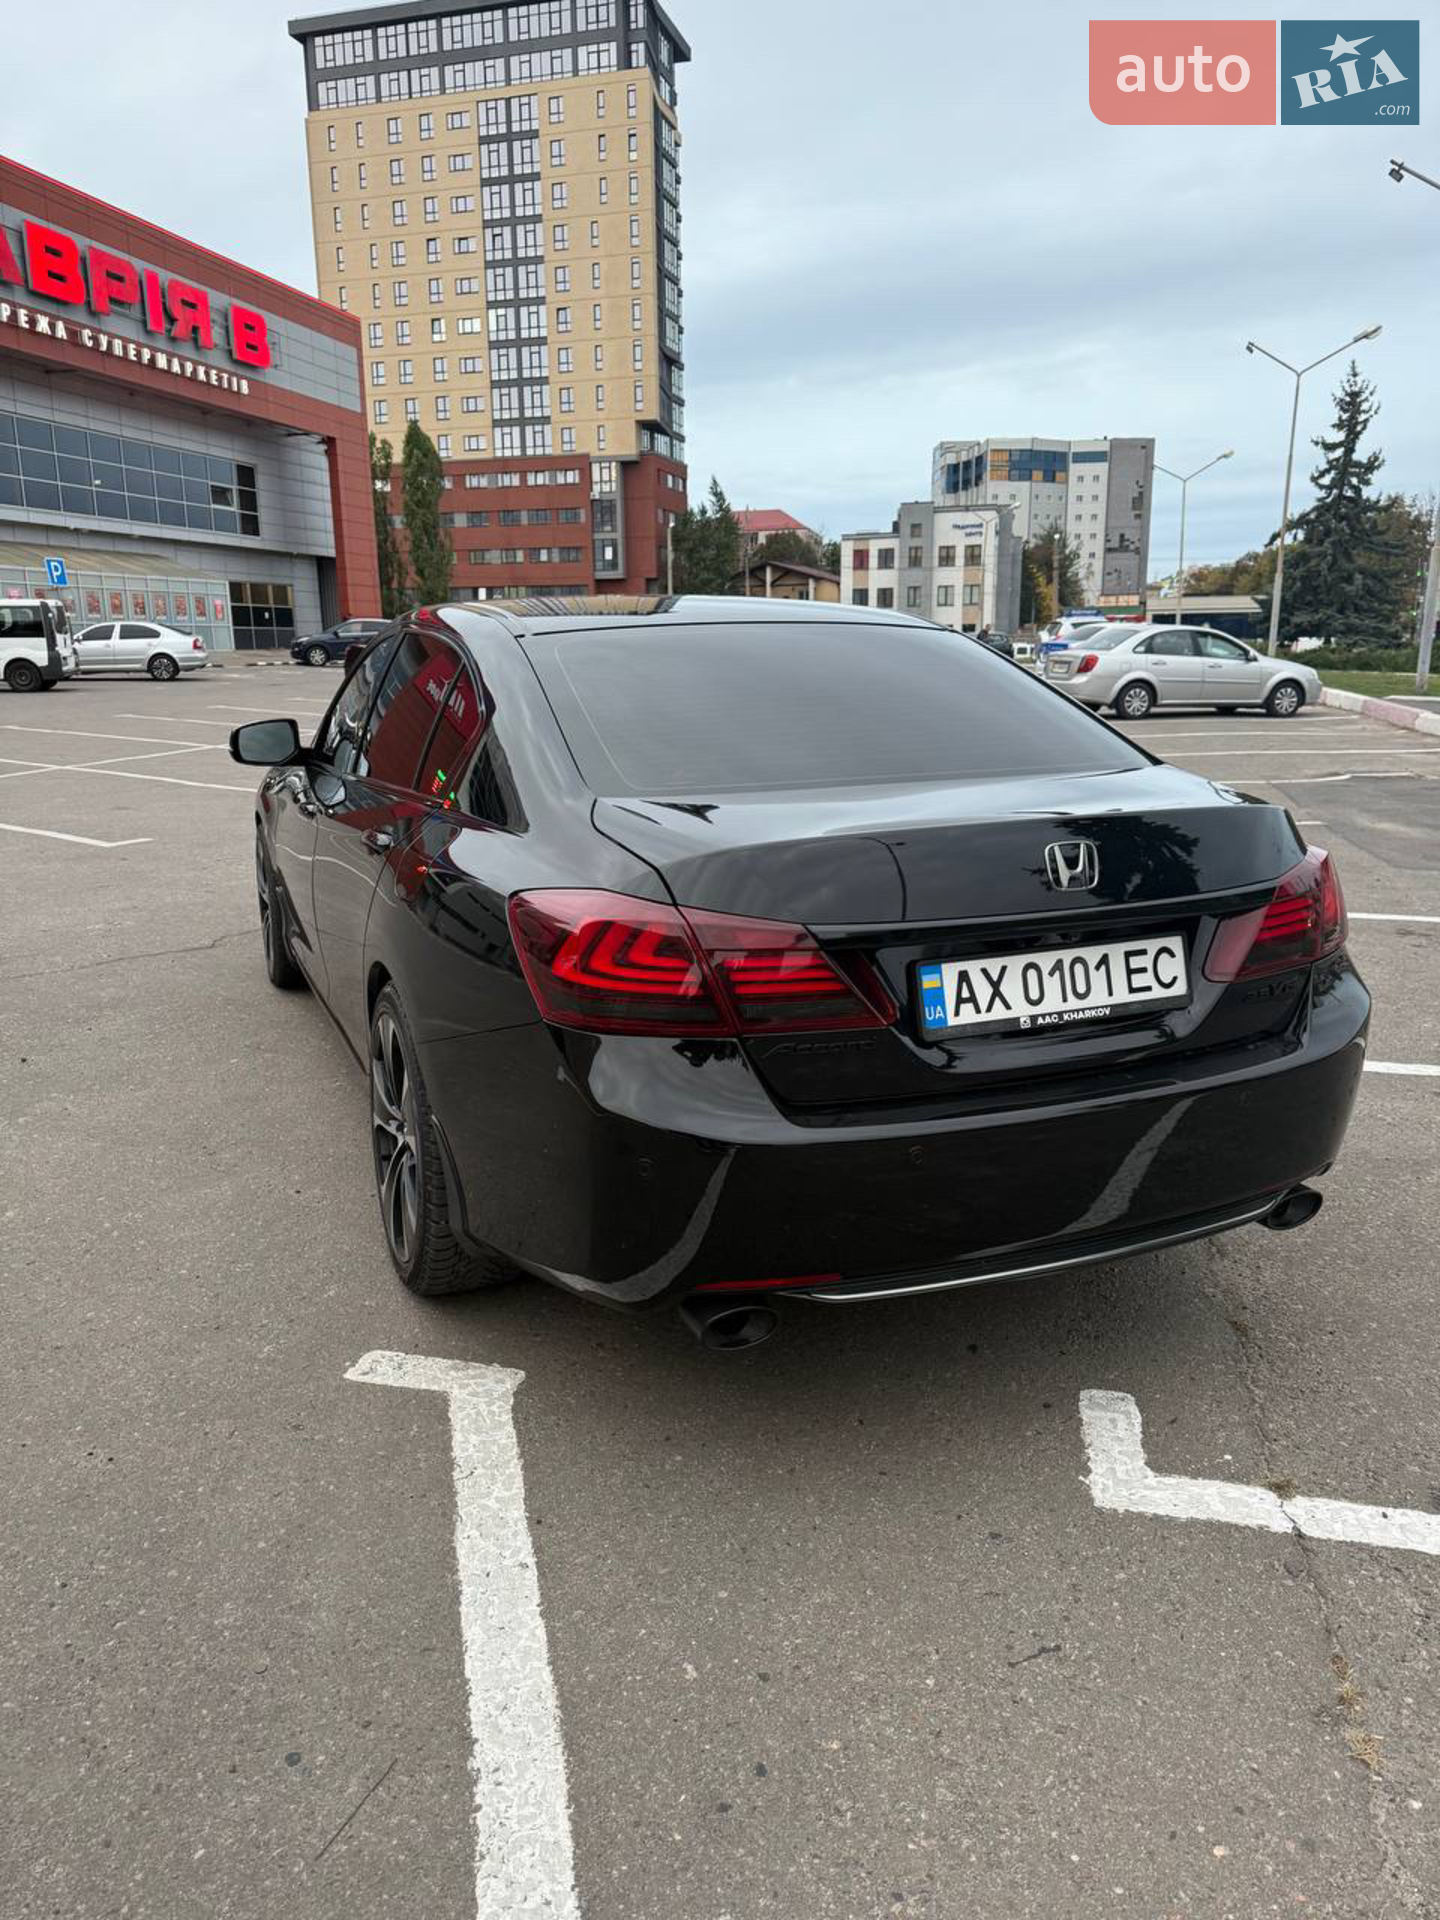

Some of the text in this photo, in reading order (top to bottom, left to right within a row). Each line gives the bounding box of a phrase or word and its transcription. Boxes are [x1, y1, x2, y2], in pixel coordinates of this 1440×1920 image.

[229, 303, 272, 370] В
[82, 329, 251, 396] СУПЕРМАРКЕТІВ
[50, 562, 62, 583] P
[953, 946, 1179, 1017] AX 0101 EC
[925, 1005, 946, 1021] UA
[1036, 1007, 1112, 1026] AAC_KHARKOV
